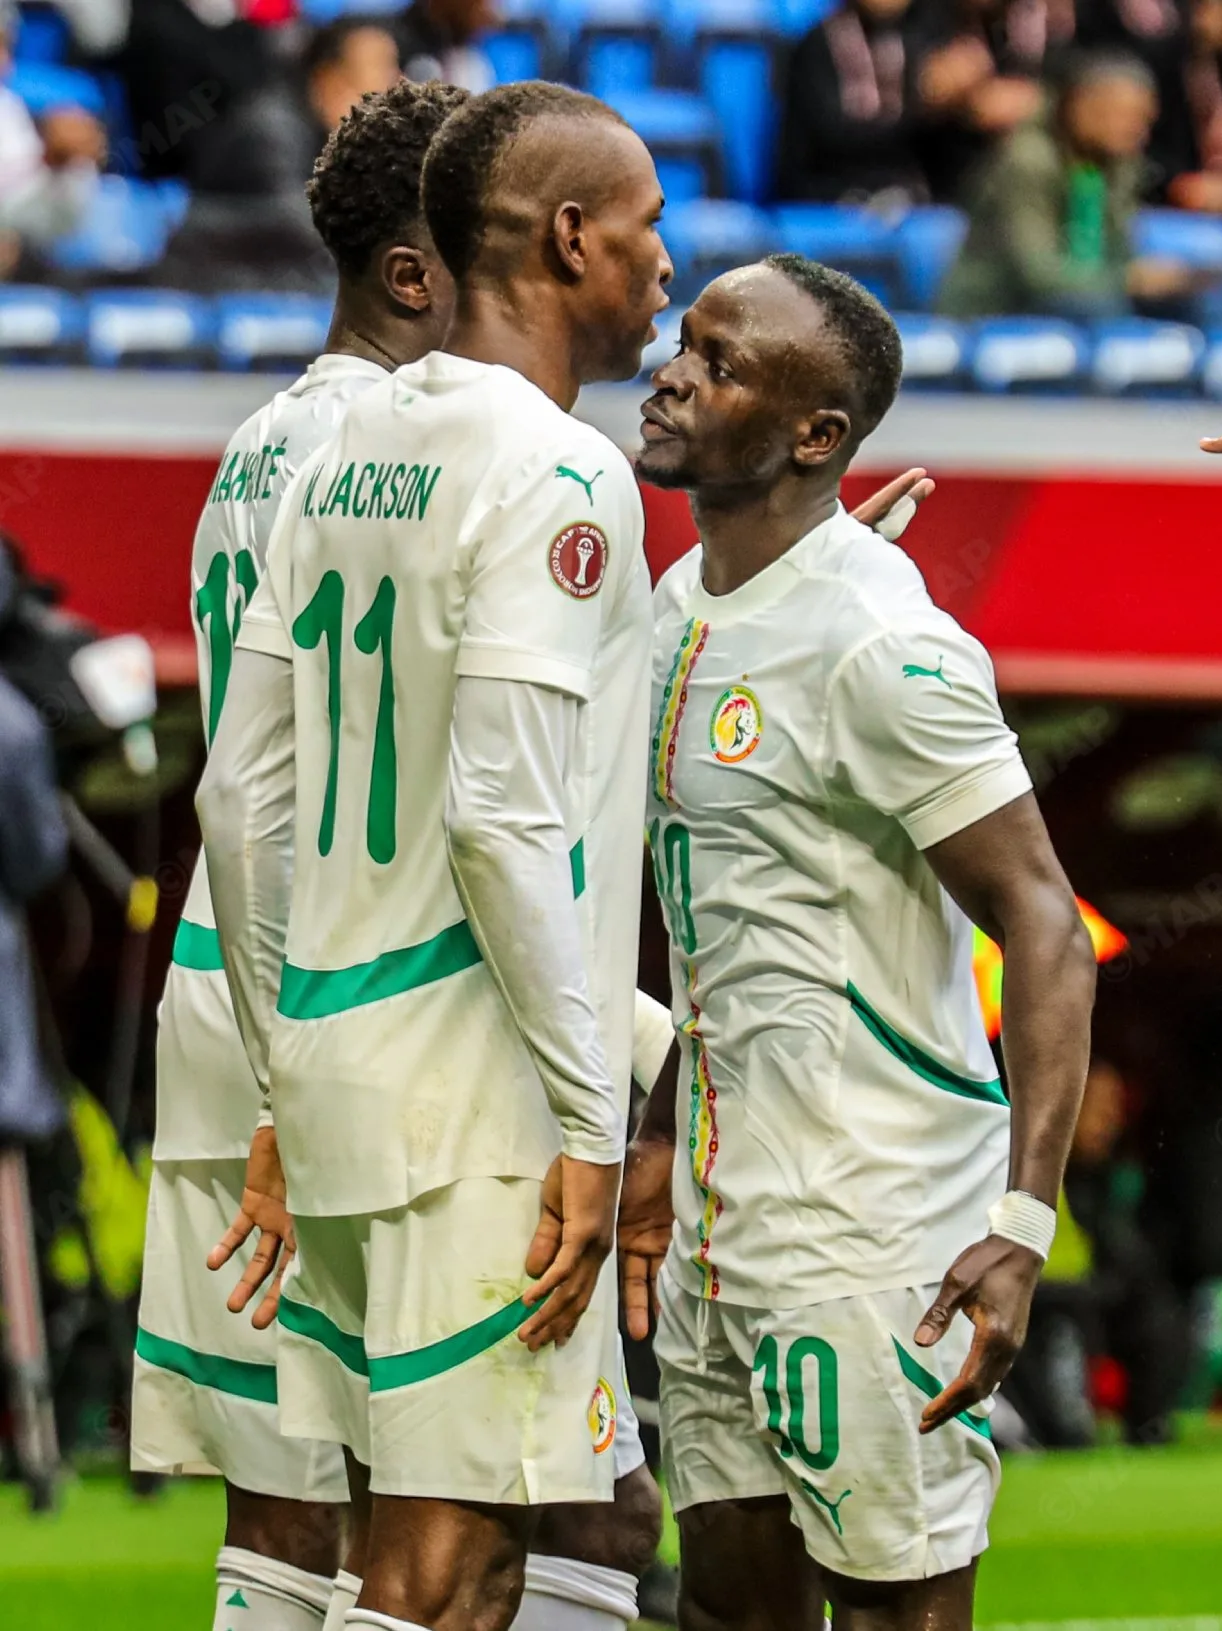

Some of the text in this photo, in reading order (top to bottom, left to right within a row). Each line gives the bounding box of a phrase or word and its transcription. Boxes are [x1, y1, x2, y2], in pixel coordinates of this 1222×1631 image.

[318, 461, 442, 521] JACKSON
[292, 569, 396, 865] 11
[752, 1333, 840, 1471] 10
